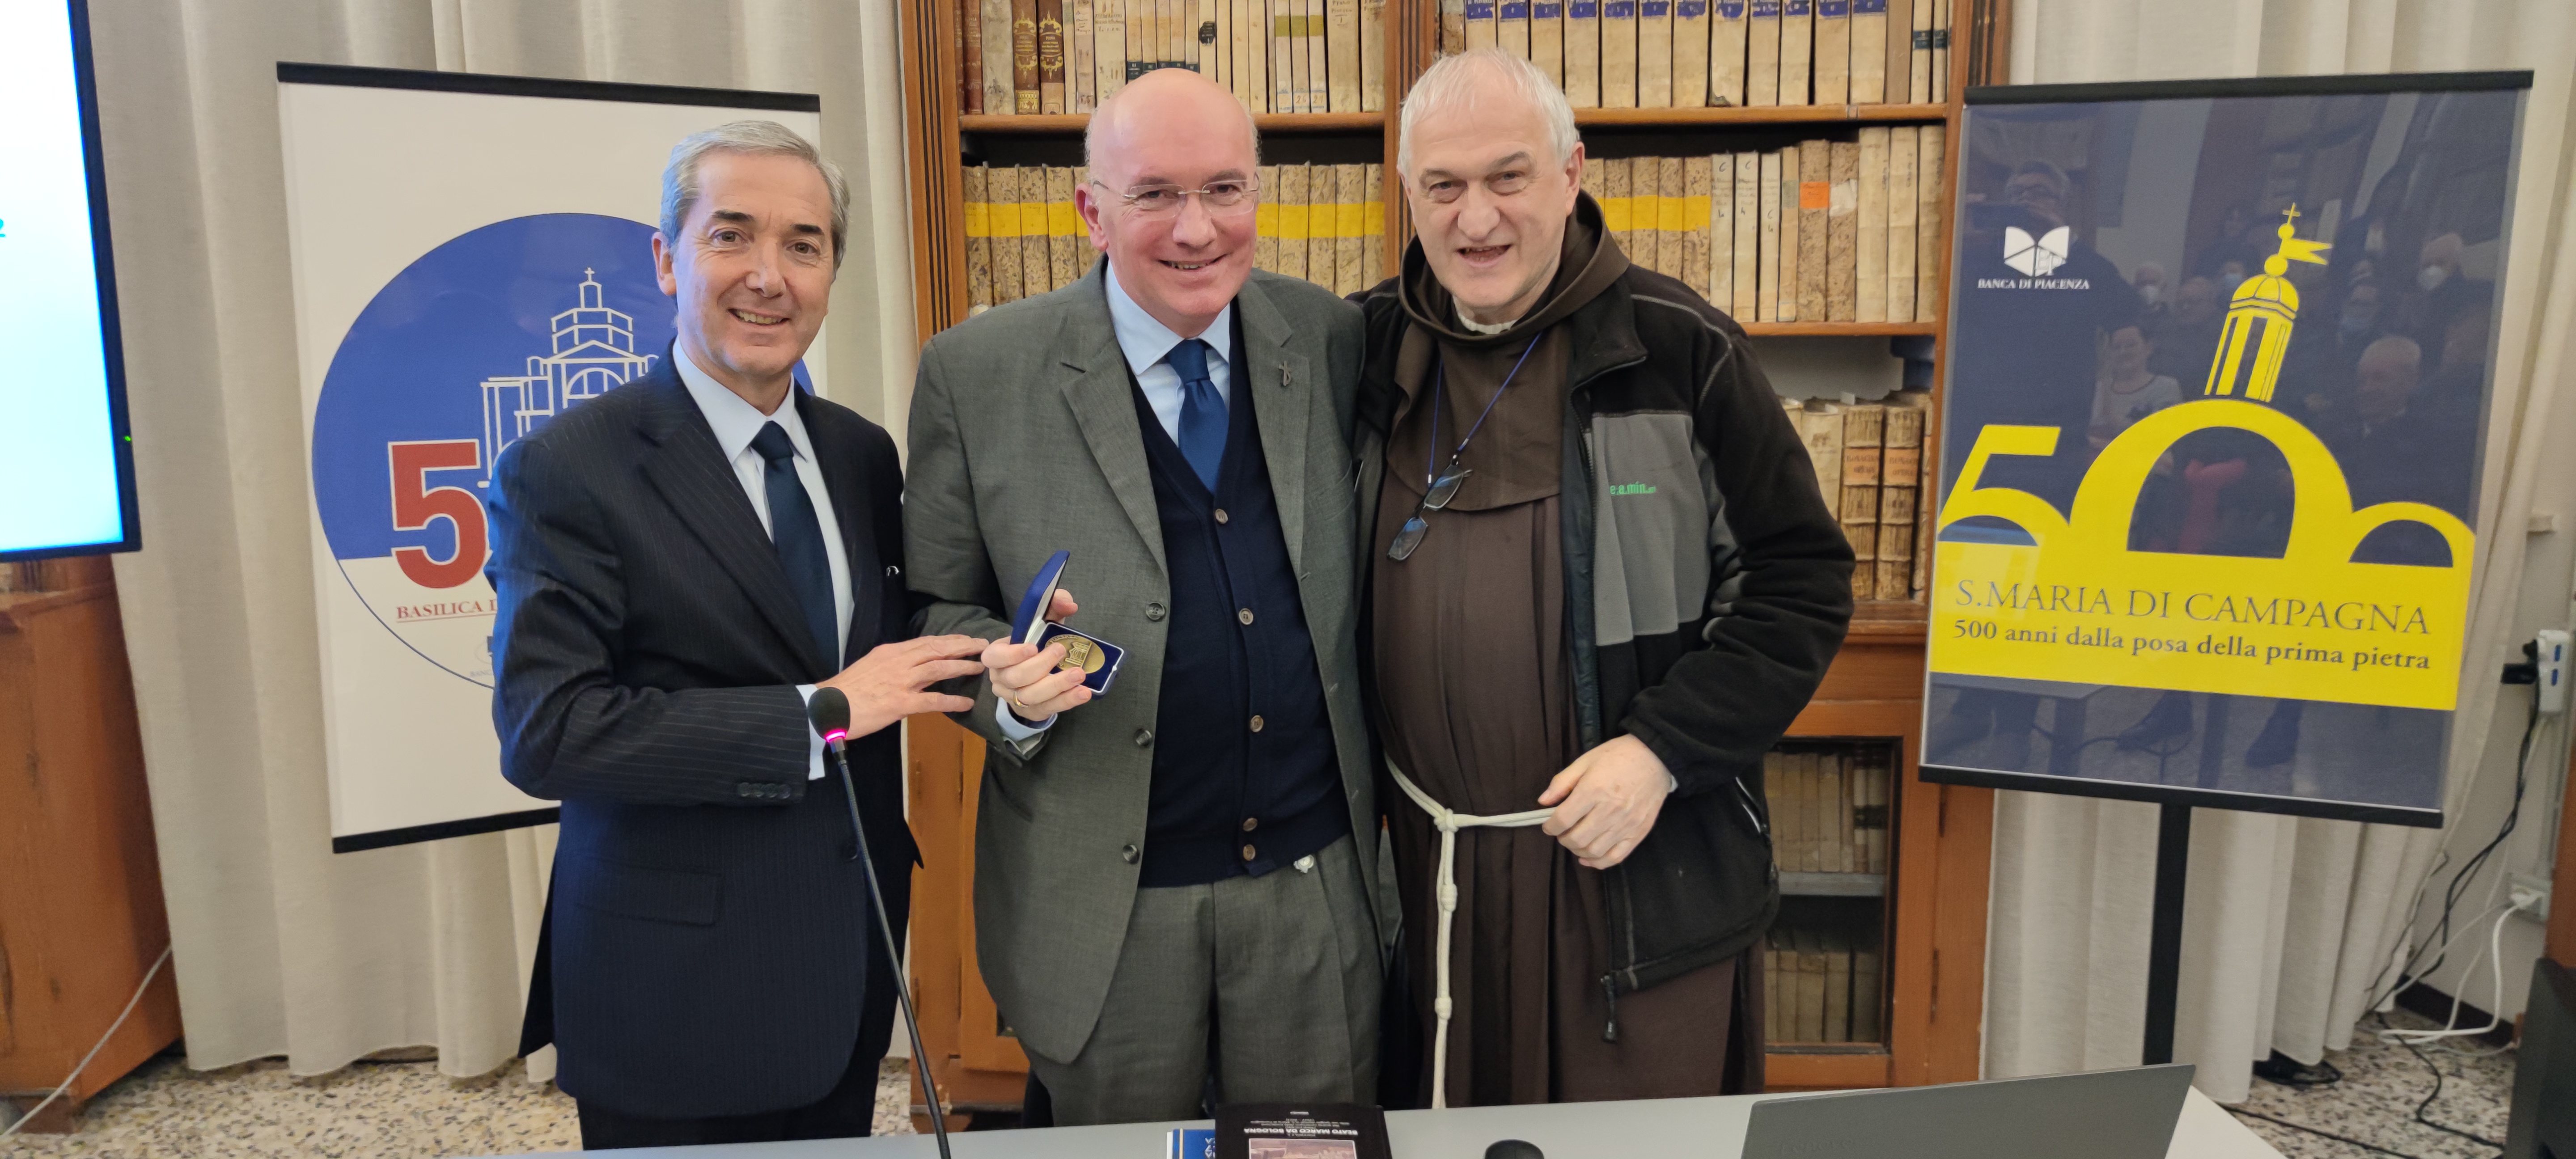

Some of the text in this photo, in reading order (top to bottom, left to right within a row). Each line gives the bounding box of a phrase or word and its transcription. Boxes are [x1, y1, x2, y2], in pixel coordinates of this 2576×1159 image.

[1977, 278, 2090, 290] BANCA DI PIACENZA
[396, 601, 483, 619] BASILICA
[1956, 579, 2431, 634] S.MARIA DI CAMPAGNA
[1953, 620, 2431, 672] 500 anni dalla posa della prima pietra
